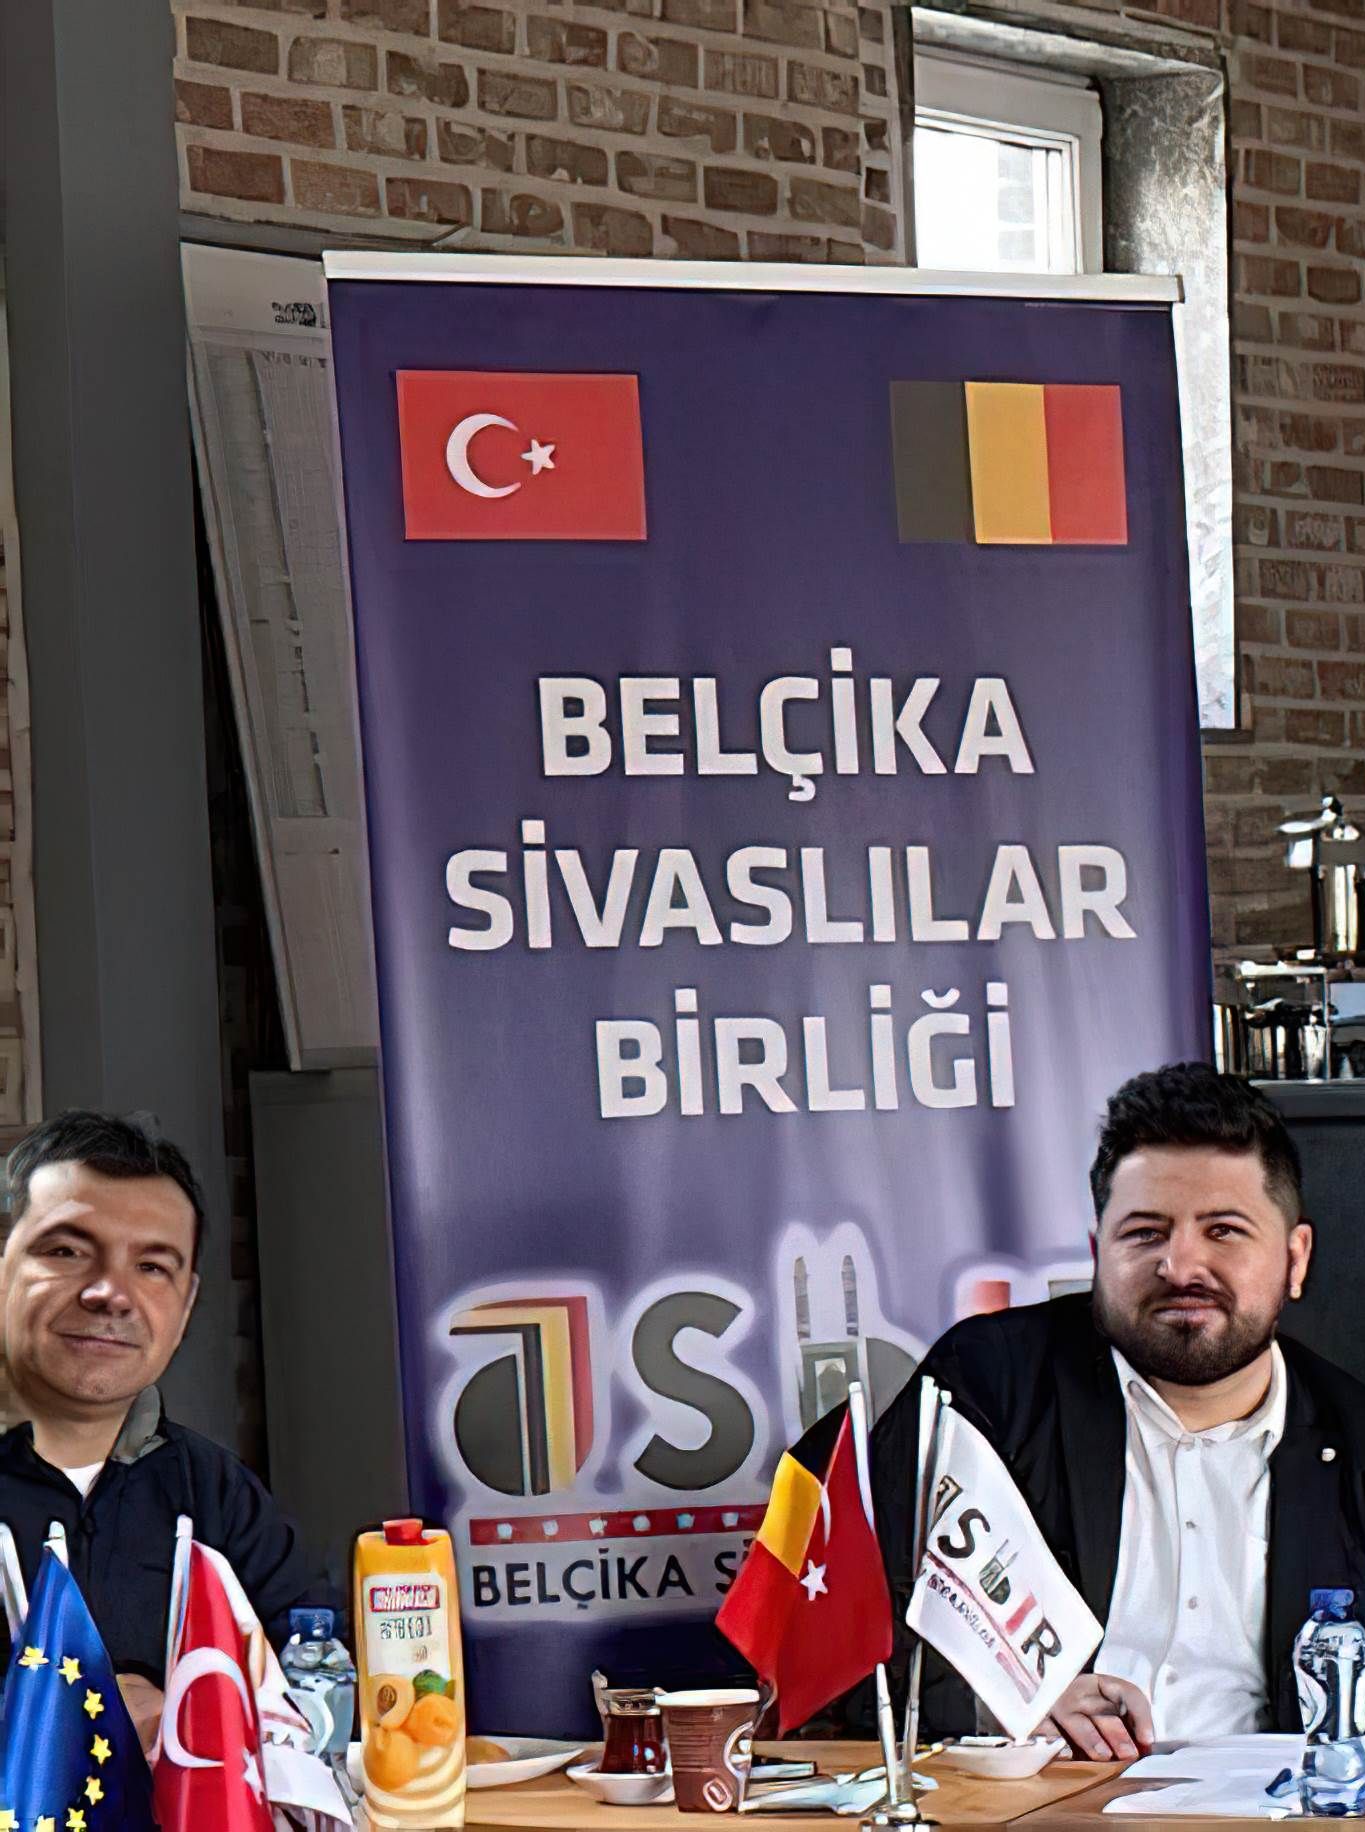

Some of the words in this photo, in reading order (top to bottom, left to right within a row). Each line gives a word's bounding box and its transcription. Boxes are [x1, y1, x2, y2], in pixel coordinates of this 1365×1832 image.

[538, 647, 1035, 802] BELÇİKA
[445, 820, 1138, 951] SİVASLILAR
[597, 982, 1016, 1119] BİRLİĞİ
[472, 1547, 695, 1610] BELÇİKA
[714, 1537, 756, 1595] S
